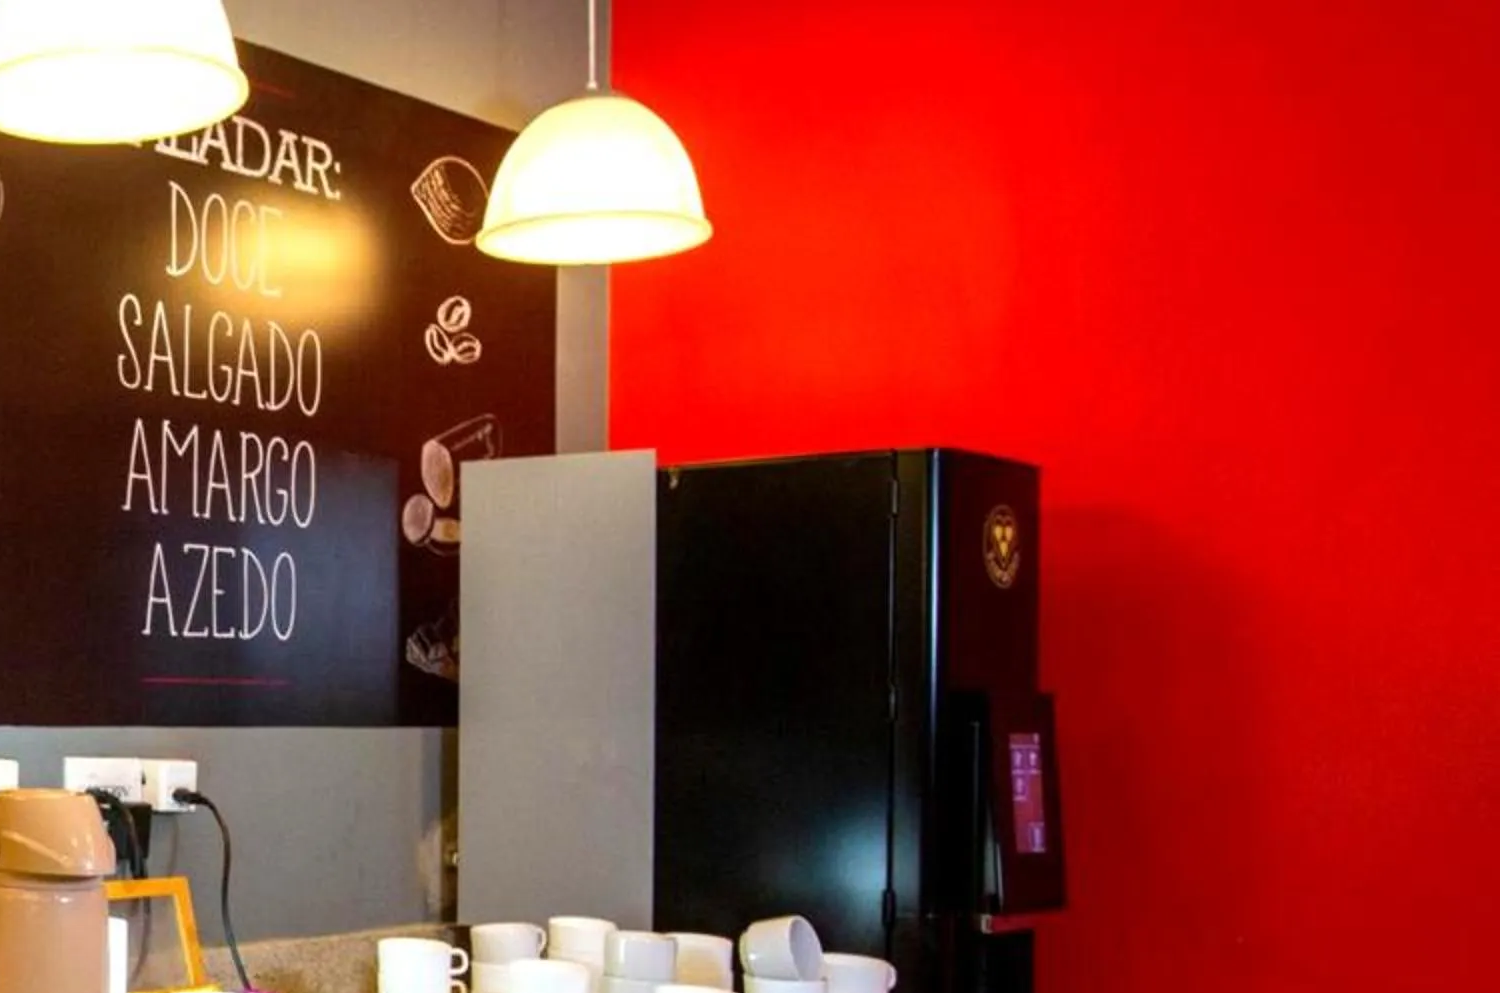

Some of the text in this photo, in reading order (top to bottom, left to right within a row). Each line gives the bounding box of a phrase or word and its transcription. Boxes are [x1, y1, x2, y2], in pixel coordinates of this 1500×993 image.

[165, 180, 283, 298] DOCE
[116, 292, 324, 417] SALGADO
[121, 417, 317, 529] AMARGO
[140, 542, 298, 641] AZEDO
